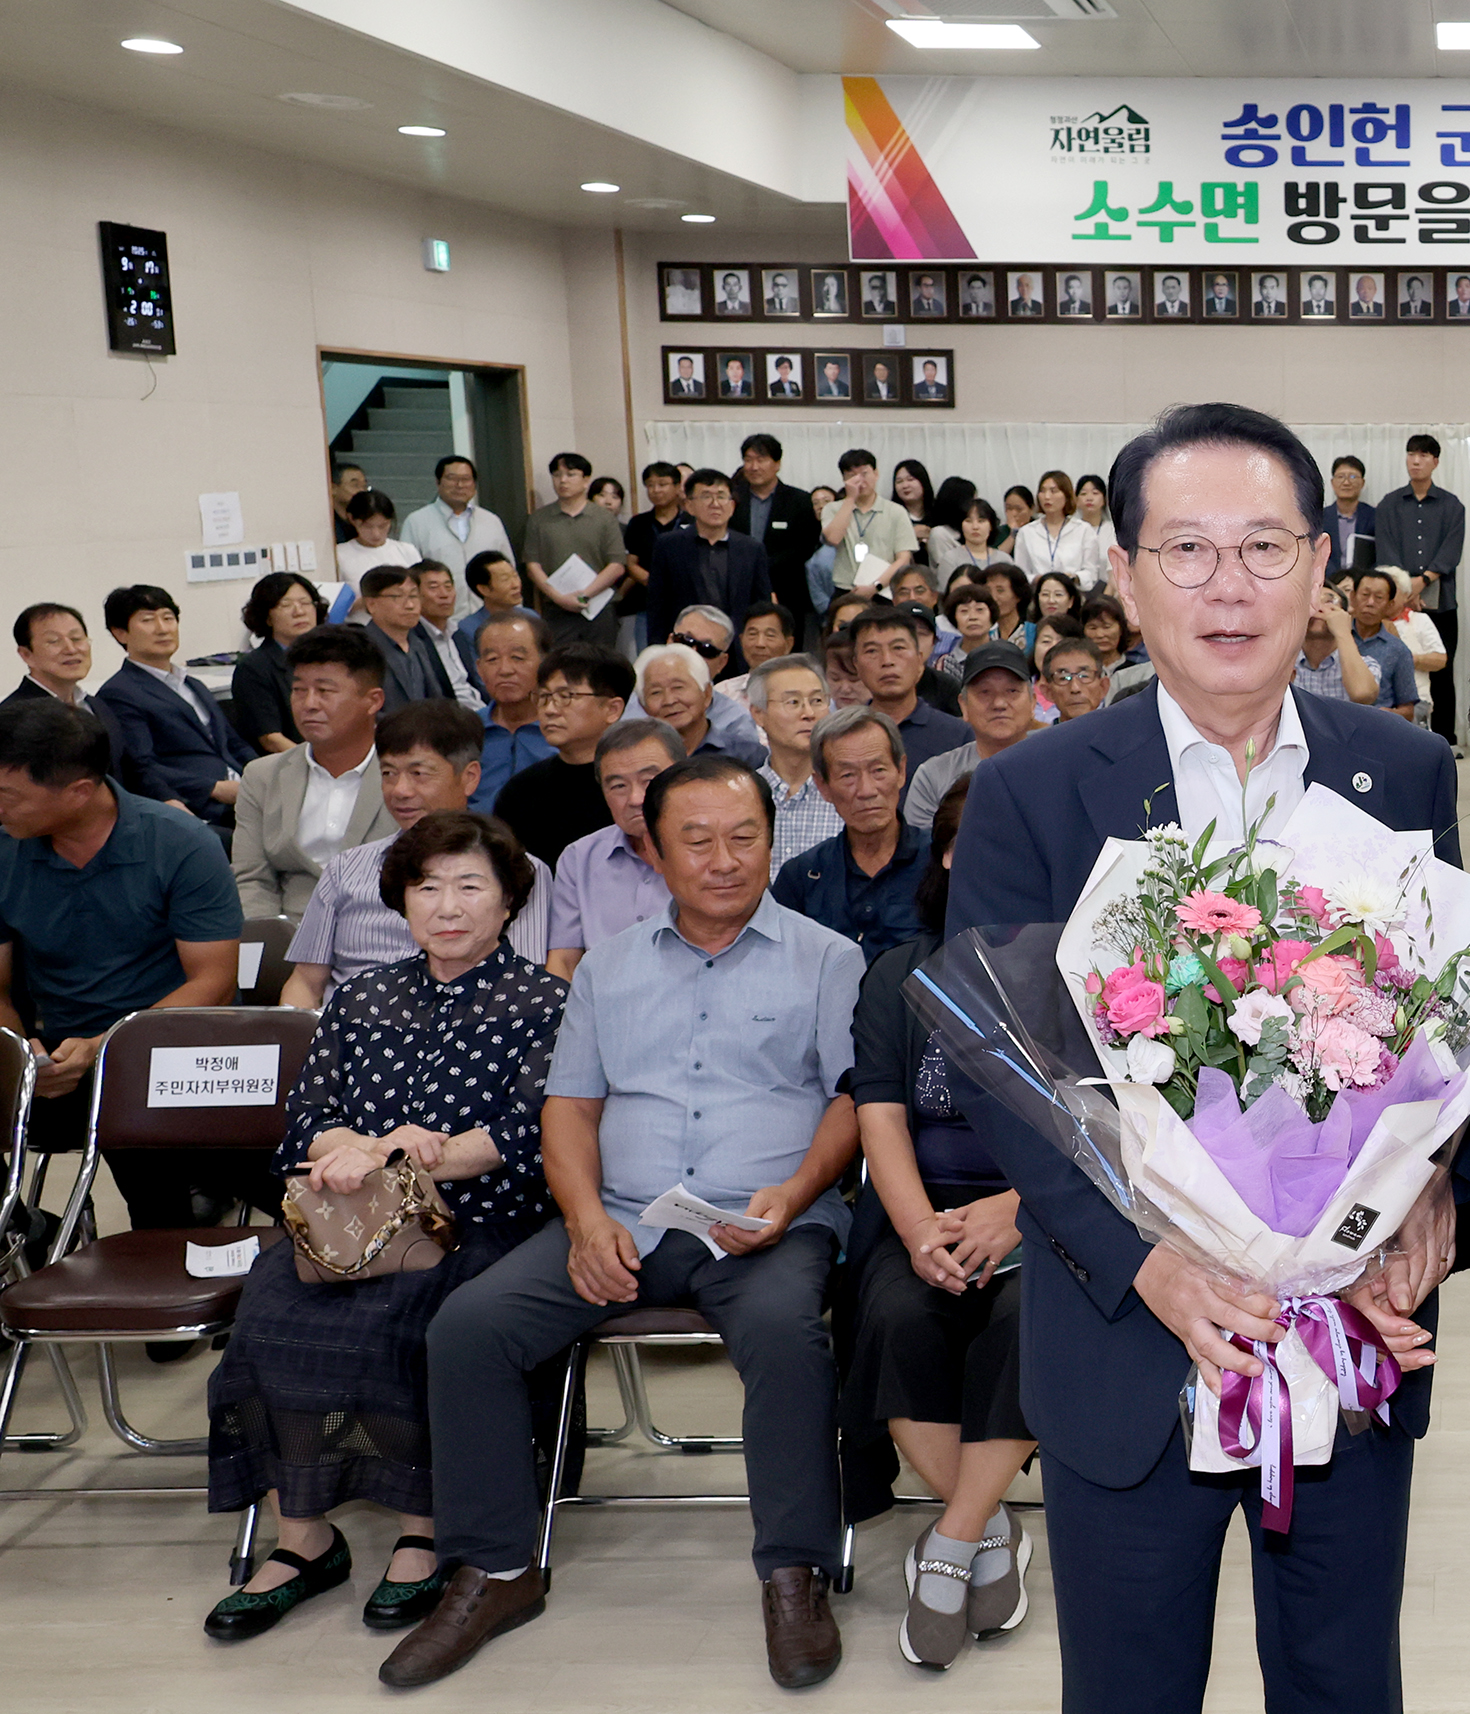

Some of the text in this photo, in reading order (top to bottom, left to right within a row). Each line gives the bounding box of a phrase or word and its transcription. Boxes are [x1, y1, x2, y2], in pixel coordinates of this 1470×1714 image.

[1050, 126, 1150, 154] 자연울림
[1220, 101, 1411, 169] 송인헌
[1071, 180, 1260, 244] 소수면
[195, 1056, 239, 1072] 박정애
[155, 1078, 275, 1096] 주민자치부위원장
